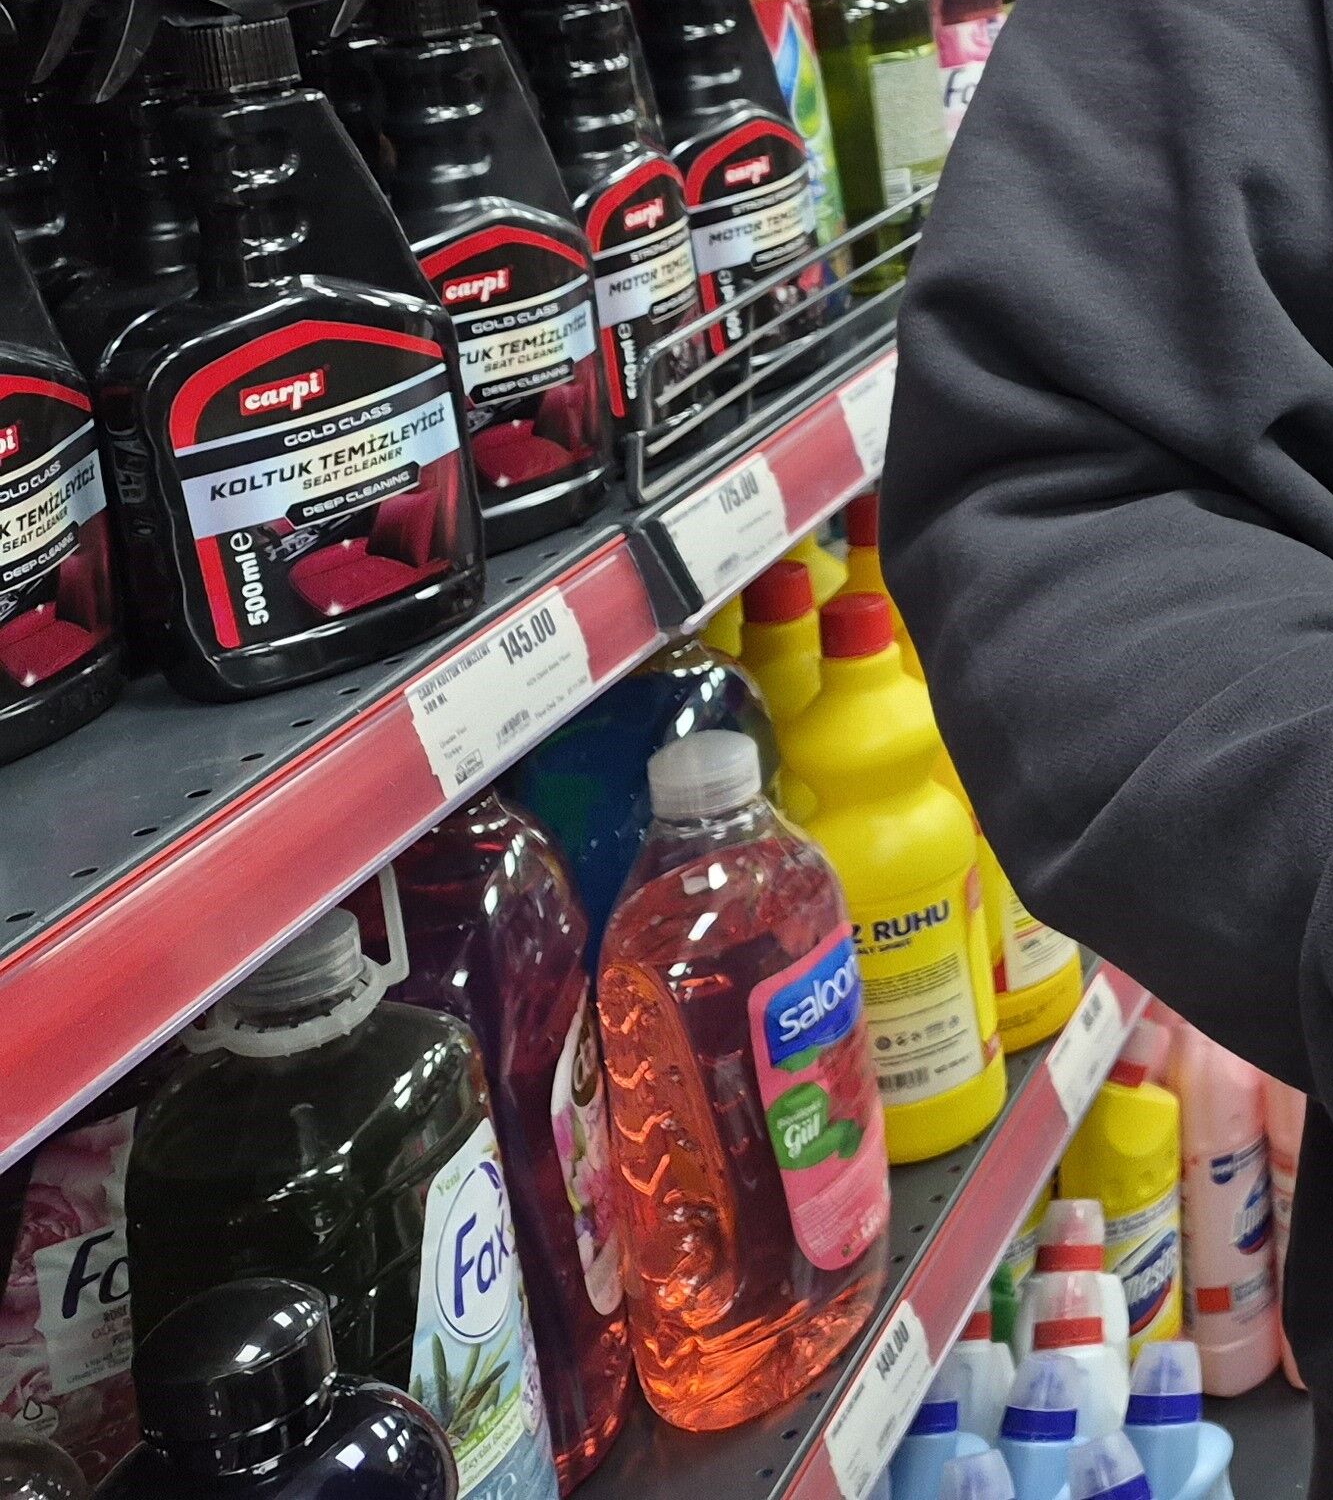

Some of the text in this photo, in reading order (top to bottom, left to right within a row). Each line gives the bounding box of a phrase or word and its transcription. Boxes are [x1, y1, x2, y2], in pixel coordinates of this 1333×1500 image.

[445, 268, 508, 303] carpi
[243, 370, 322, 412] carpi
[282, 402, 395, 448] GOLD CLASS
[29, 458, 62, 489] CLASS
[209, 402, 446, 502] KOLTUK TEMİZLEYİCİ
[302, 446, 403, 491] SEAT CLEANER
[15, 459, 96, 533] TEMİZLEYİCİ
[302, 470, 411, 518] DEEP CLEANING
[2, 529, 35, 554] SEAT
[2, 560, 39, 583] DEEP
[498, 607, 558, 666] 145.00
[872, 898, 951, 943] RUHU
